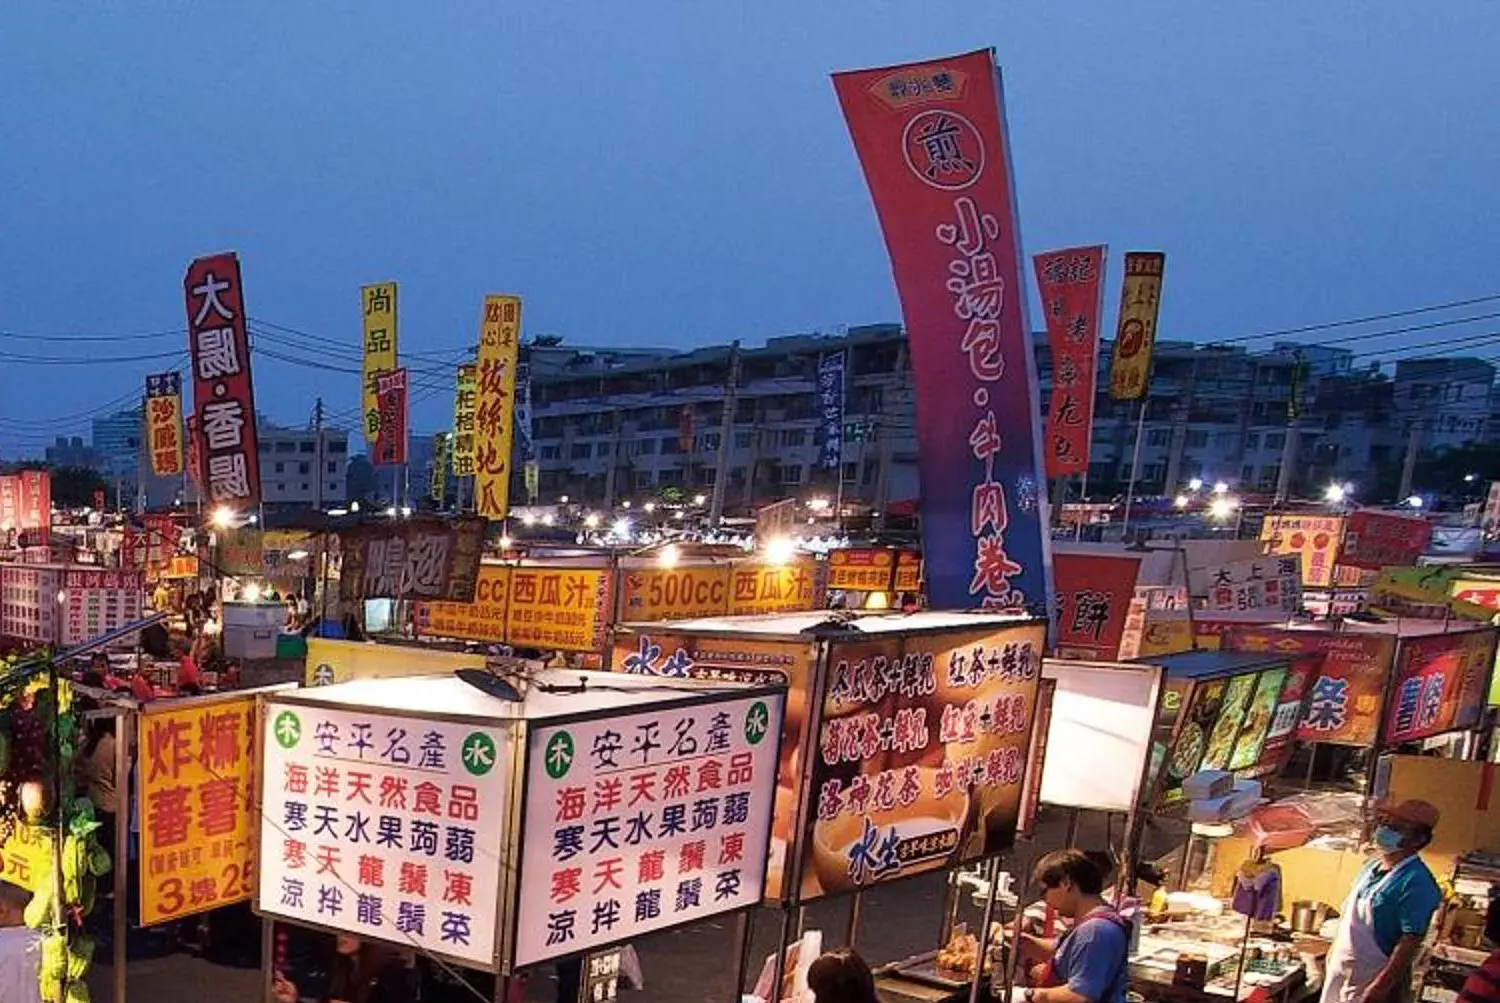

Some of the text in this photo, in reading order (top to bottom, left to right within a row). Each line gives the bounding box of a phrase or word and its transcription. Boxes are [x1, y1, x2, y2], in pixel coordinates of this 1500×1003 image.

[514, 574, 591, 606] 西瓜汁
[734, 567, 813, 602] 西瓜汁
[313, 719, 448, 769] 安平名產
[590, 711, 733, 769] 安平名產
[283, 761, 480, 822] 海洋天然食品
[555, 751, 754, 823] 海洋天然食品
[283, 799, 477, 865] 寒天水果蒟蒻
[552, 791, 751, 862] 寒天水果蒟蒻
